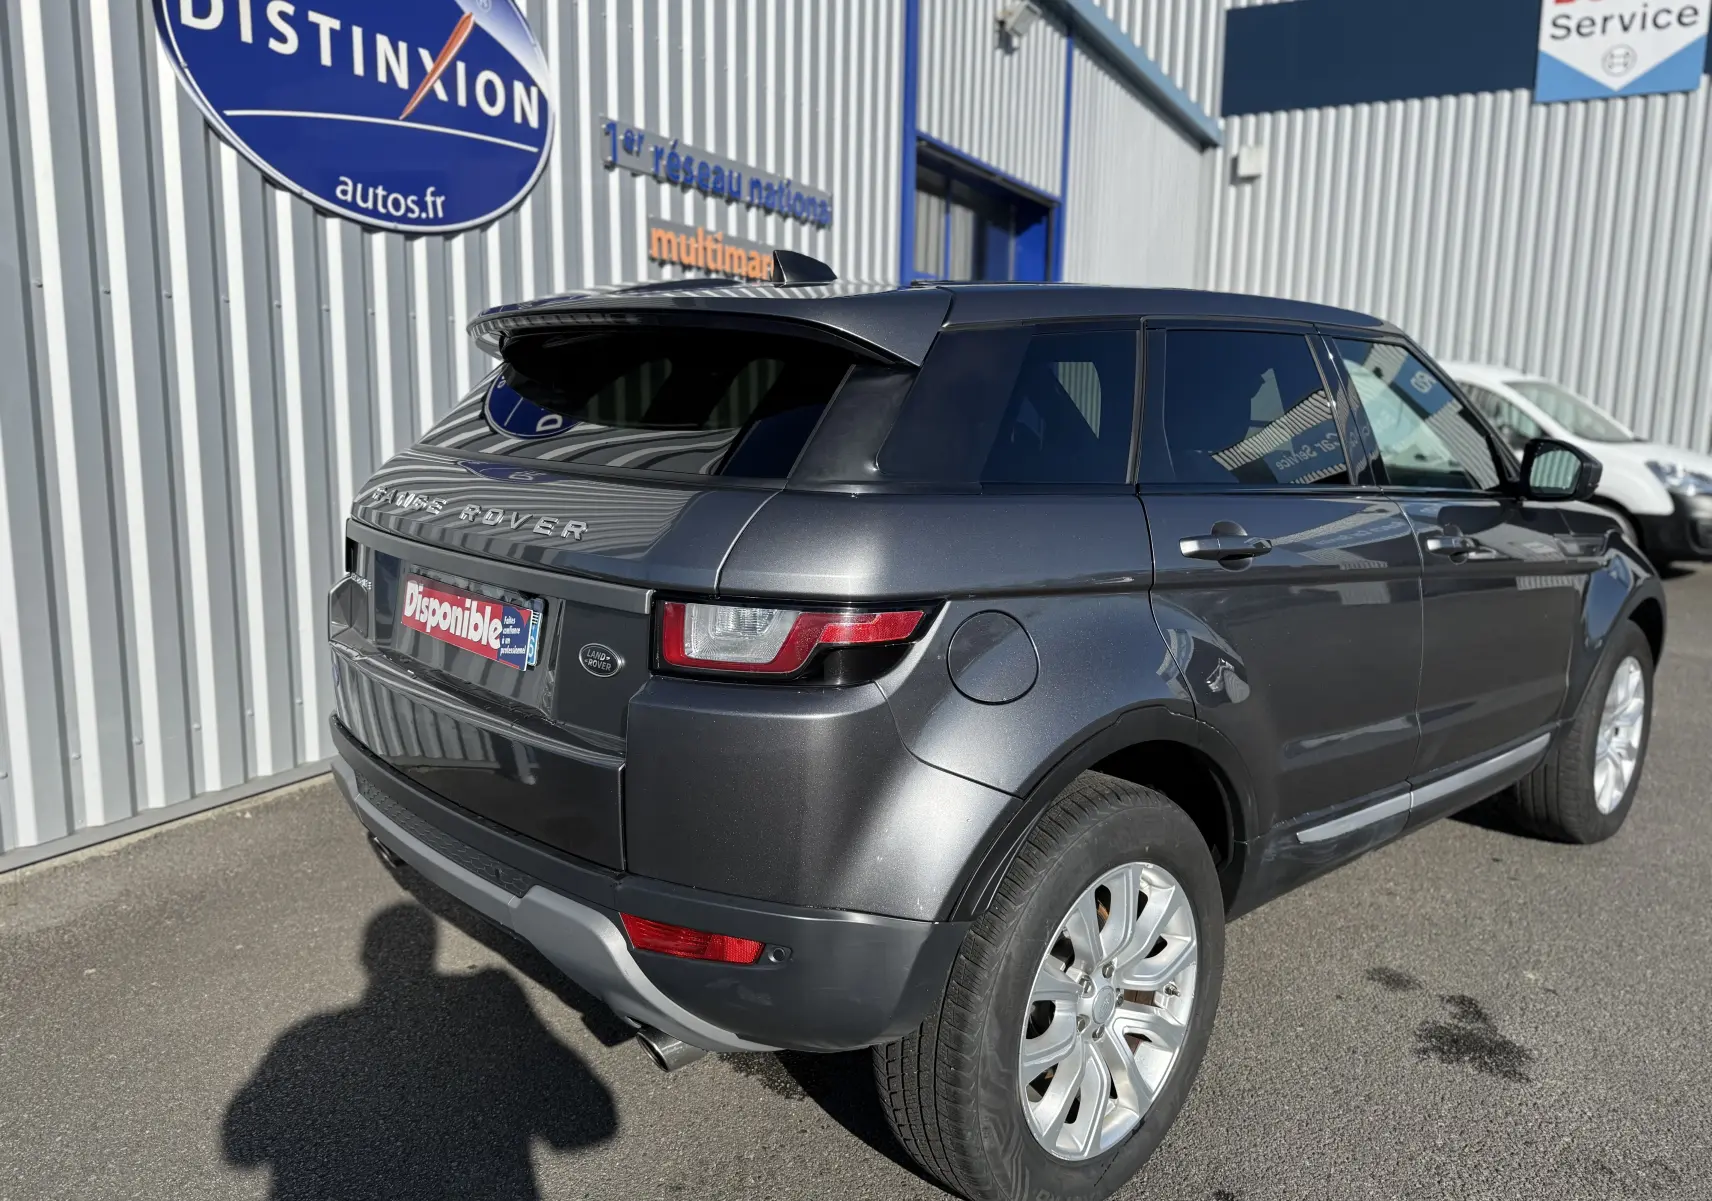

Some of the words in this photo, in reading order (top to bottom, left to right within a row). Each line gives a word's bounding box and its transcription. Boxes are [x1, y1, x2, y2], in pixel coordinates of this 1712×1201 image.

[1550, 2, 1700, 41] Service
[180, 0, 539, 129] DISTINXION
[653, 139, 743, 199] réseau
[335, 175, 446, 219] autos.fr
[651, 227, 774, 280] multimar
[458, 503, 589, 541] ROVER
[403, 579, 502, 650] Disponible
[586, 648, 607, 661] LAND
[588, 659, 612, 672] ROVER
